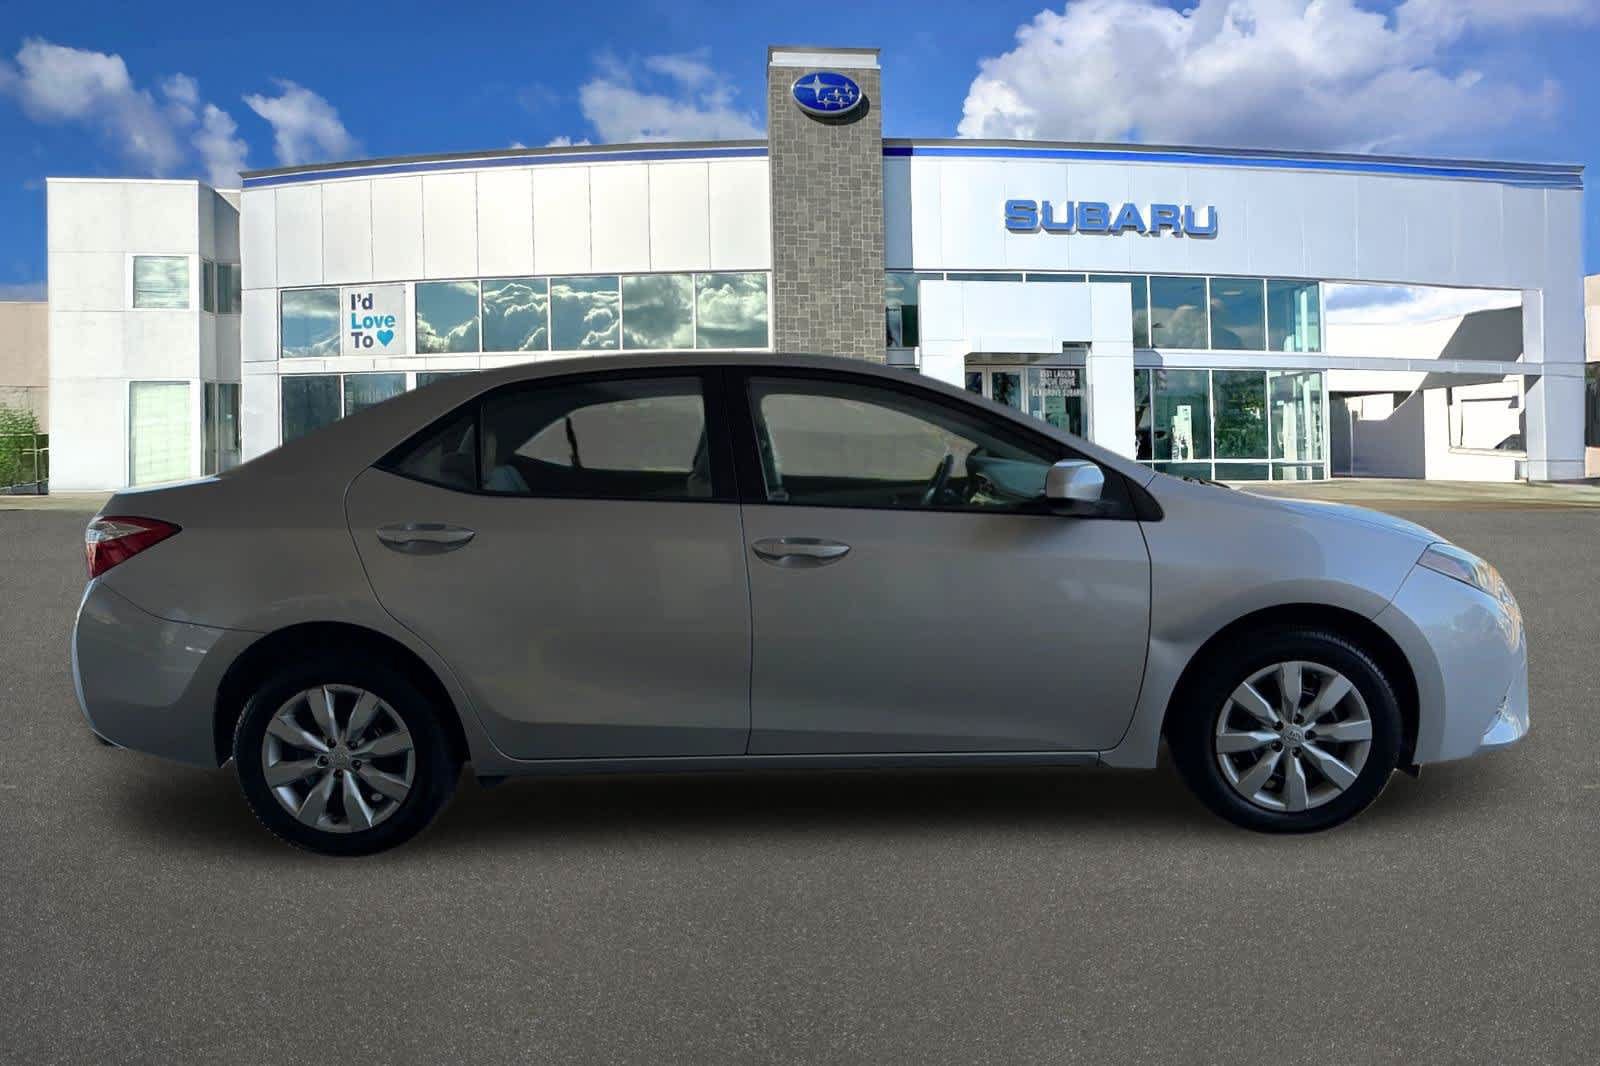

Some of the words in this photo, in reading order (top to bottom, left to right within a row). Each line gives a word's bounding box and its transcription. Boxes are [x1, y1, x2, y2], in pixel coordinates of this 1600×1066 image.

[1005, 200, 1217, 238] SUBARU
[351, 293, 373, 310] I'd
[351, 313, 396, 329] Love
[351, 332, 374, 348] To
